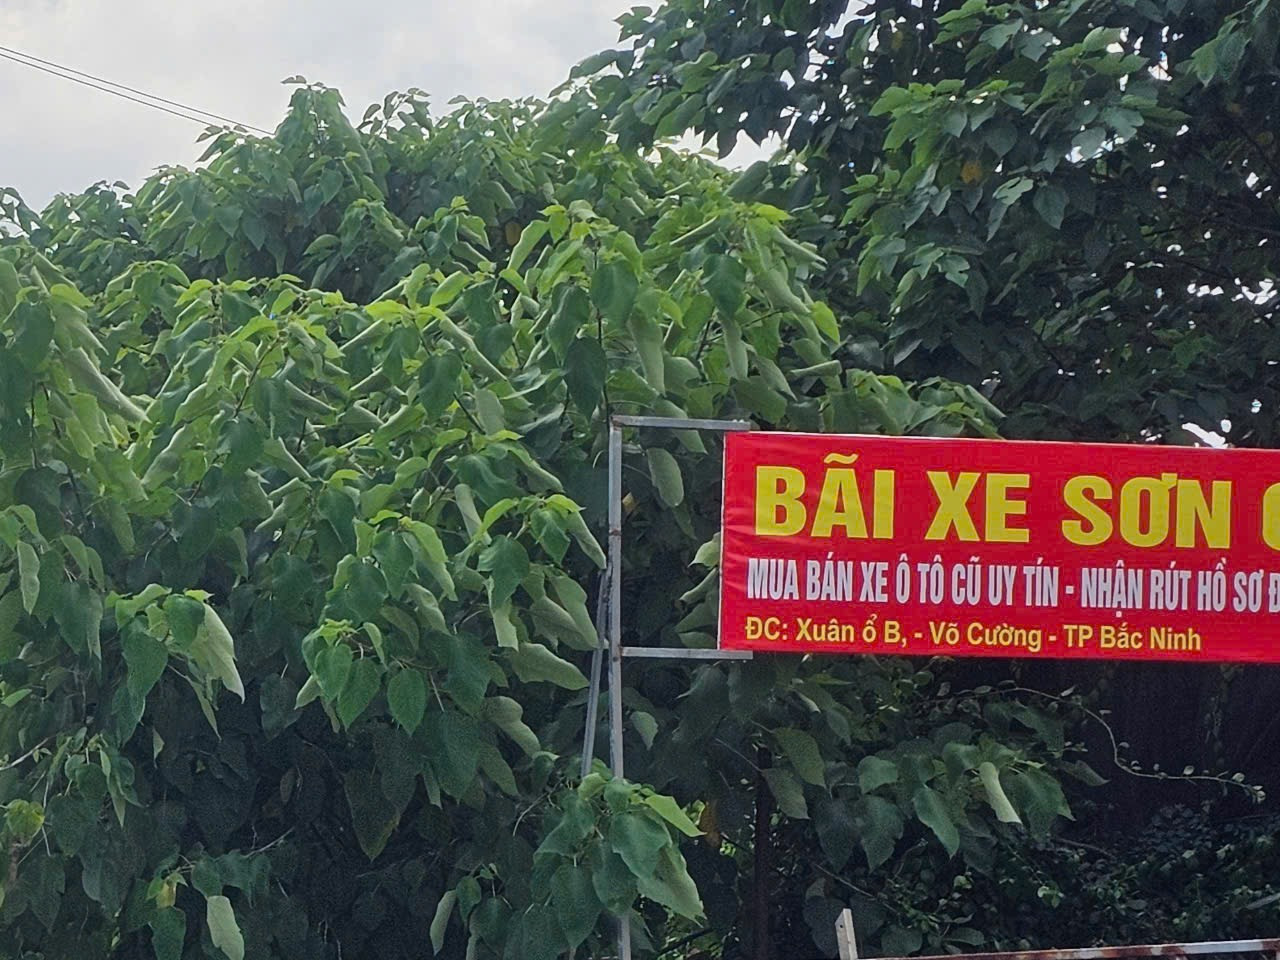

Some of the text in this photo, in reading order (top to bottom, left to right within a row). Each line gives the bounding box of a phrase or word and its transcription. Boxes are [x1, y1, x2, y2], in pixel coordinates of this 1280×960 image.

[755, 453, 894, 539] BÃI
[925, 471, 1030, 542] XE
[1062, 473, 1231, 548] SƠN
[748, 558, 799, 600] MUA
[807, 552, 853, 601] BÁN
[860, 562, 888, 602] XE
[896, 554, 910, 603] Ô
[918, 555, 944, 604] TÔ
[952, 556, 981, 605] CŨ
[989, 565, 1017, 605] UY
[1023, 558, 1058, 606] TÍN
[1082, 560, 1143, 617] NHẬN
[1150, 561, 1191, 610] RÚT
[1198, 558, 1226, 611] HỒ
[1233, 569, 1264, 612] SƠ
[745, 616, 787, 640] ĐC:
[796, 617, 854, 642] Xuân
[863, 614, 878, 643] ổ
[885, 620, 907, 647] B,
[930, 621, 959, 645] Võ
[968, 622, 1041, 652] Cường
[1064, 624, 1092, 648] TP
[1101, 622, 1142, 649] Bắc
[1151, 626, 1200, 650] Ninh
